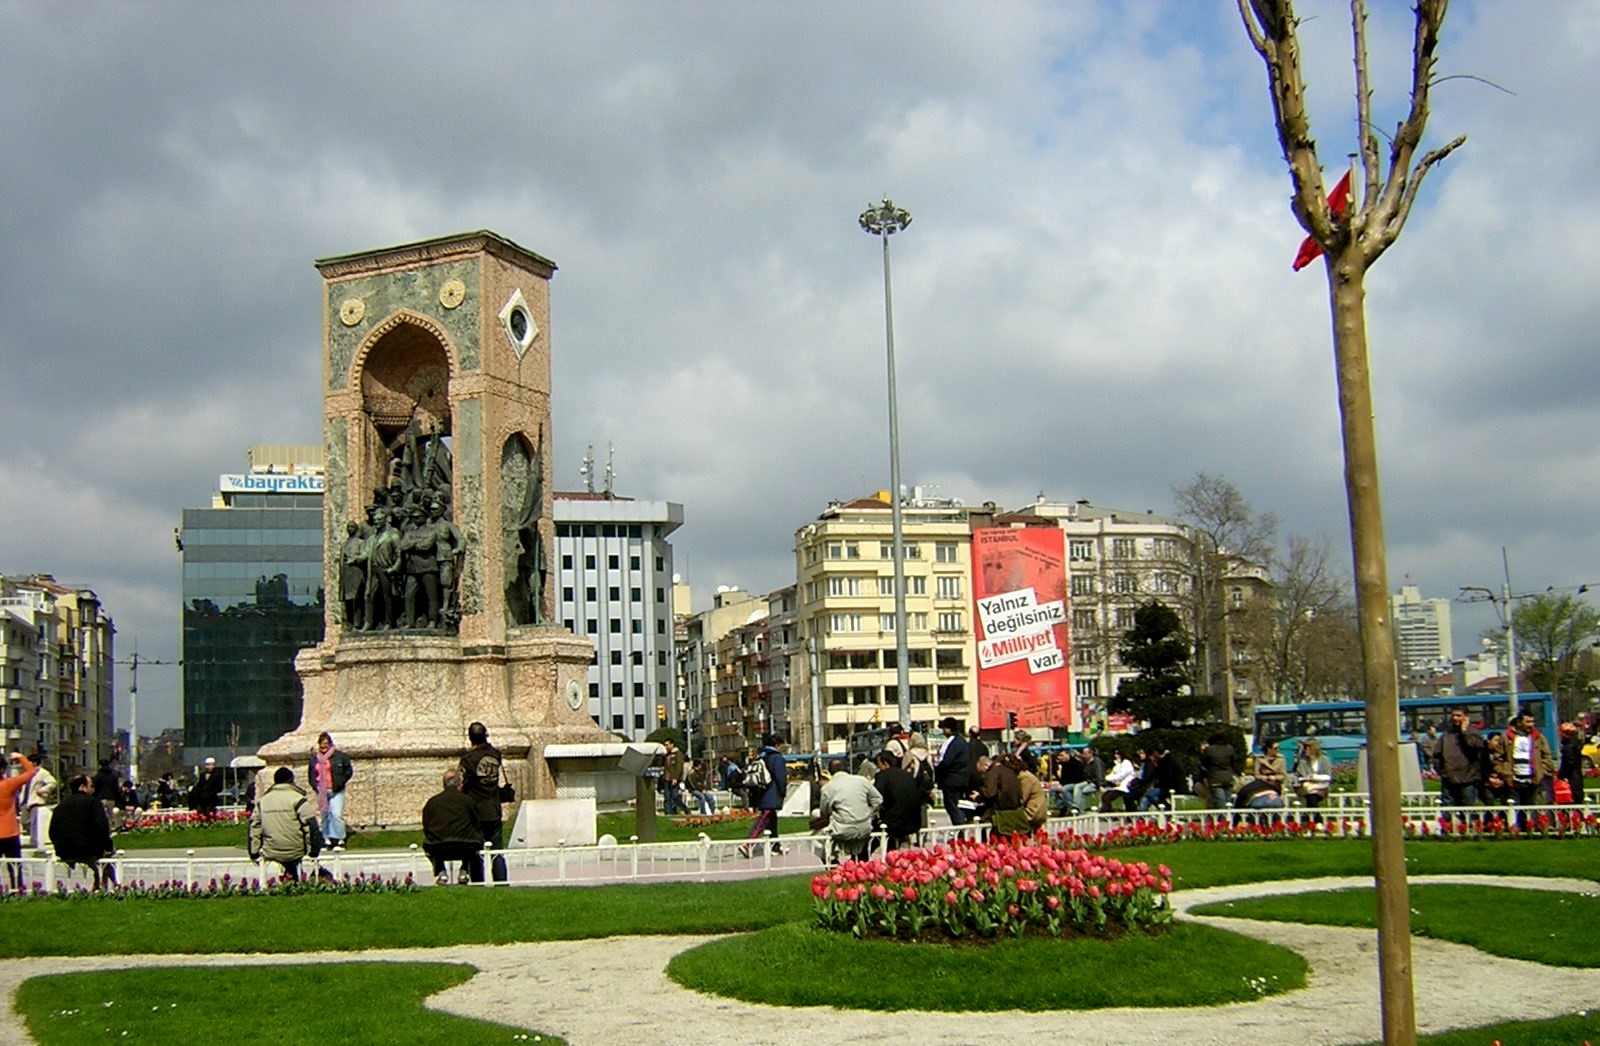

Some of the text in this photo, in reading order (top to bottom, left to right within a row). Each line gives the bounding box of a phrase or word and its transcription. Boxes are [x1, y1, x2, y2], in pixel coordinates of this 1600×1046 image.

[981, 595, 1029, 616] Yalnız
[986, 606, 1062, 635] değilsiniz
[991, 629, 1053, 658] Milliyet
[1033, 653, 1058, 669] var
